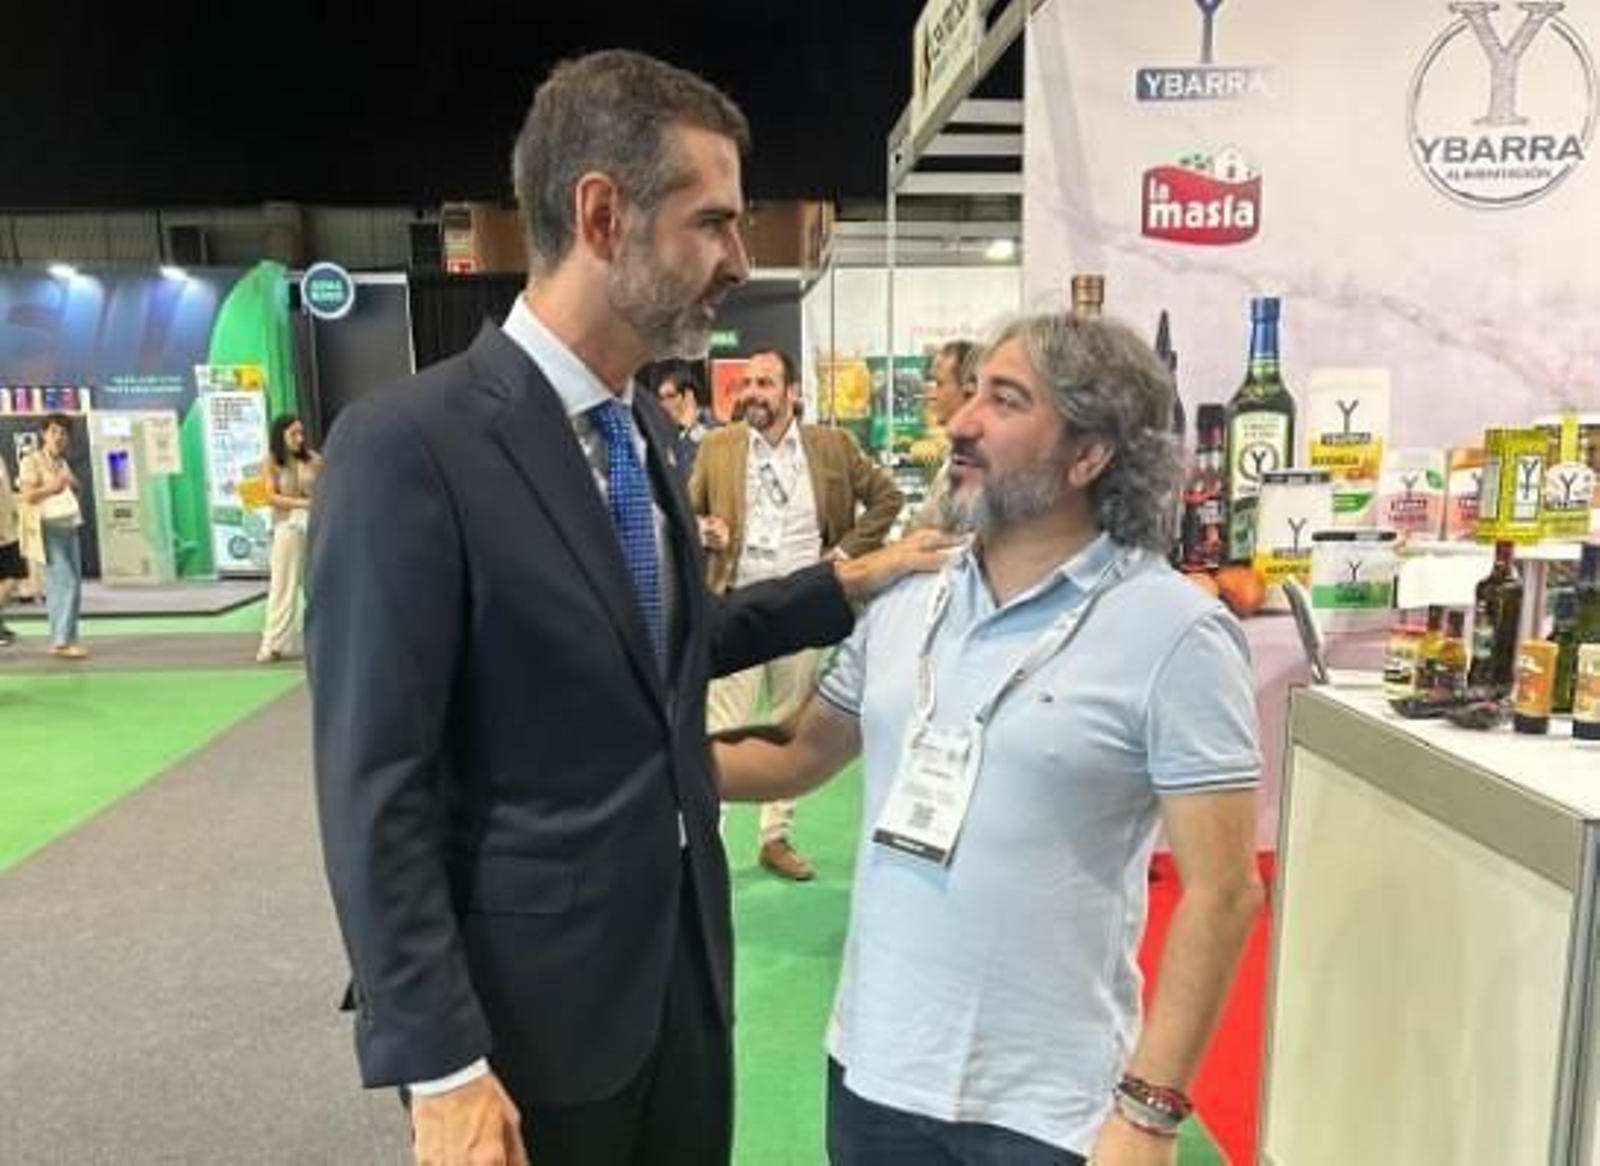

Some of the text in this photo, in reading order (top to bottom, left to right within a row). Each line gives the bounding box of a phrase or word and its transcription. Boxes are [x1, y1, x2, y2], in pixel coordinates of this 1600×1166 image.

[1448, 1, 1566, 126] Y
[1144, 71, 1267, 98] YBARRA
[1417, 135, 1585, 164] YBARRA
[1149, 177, 1170, 200] la
